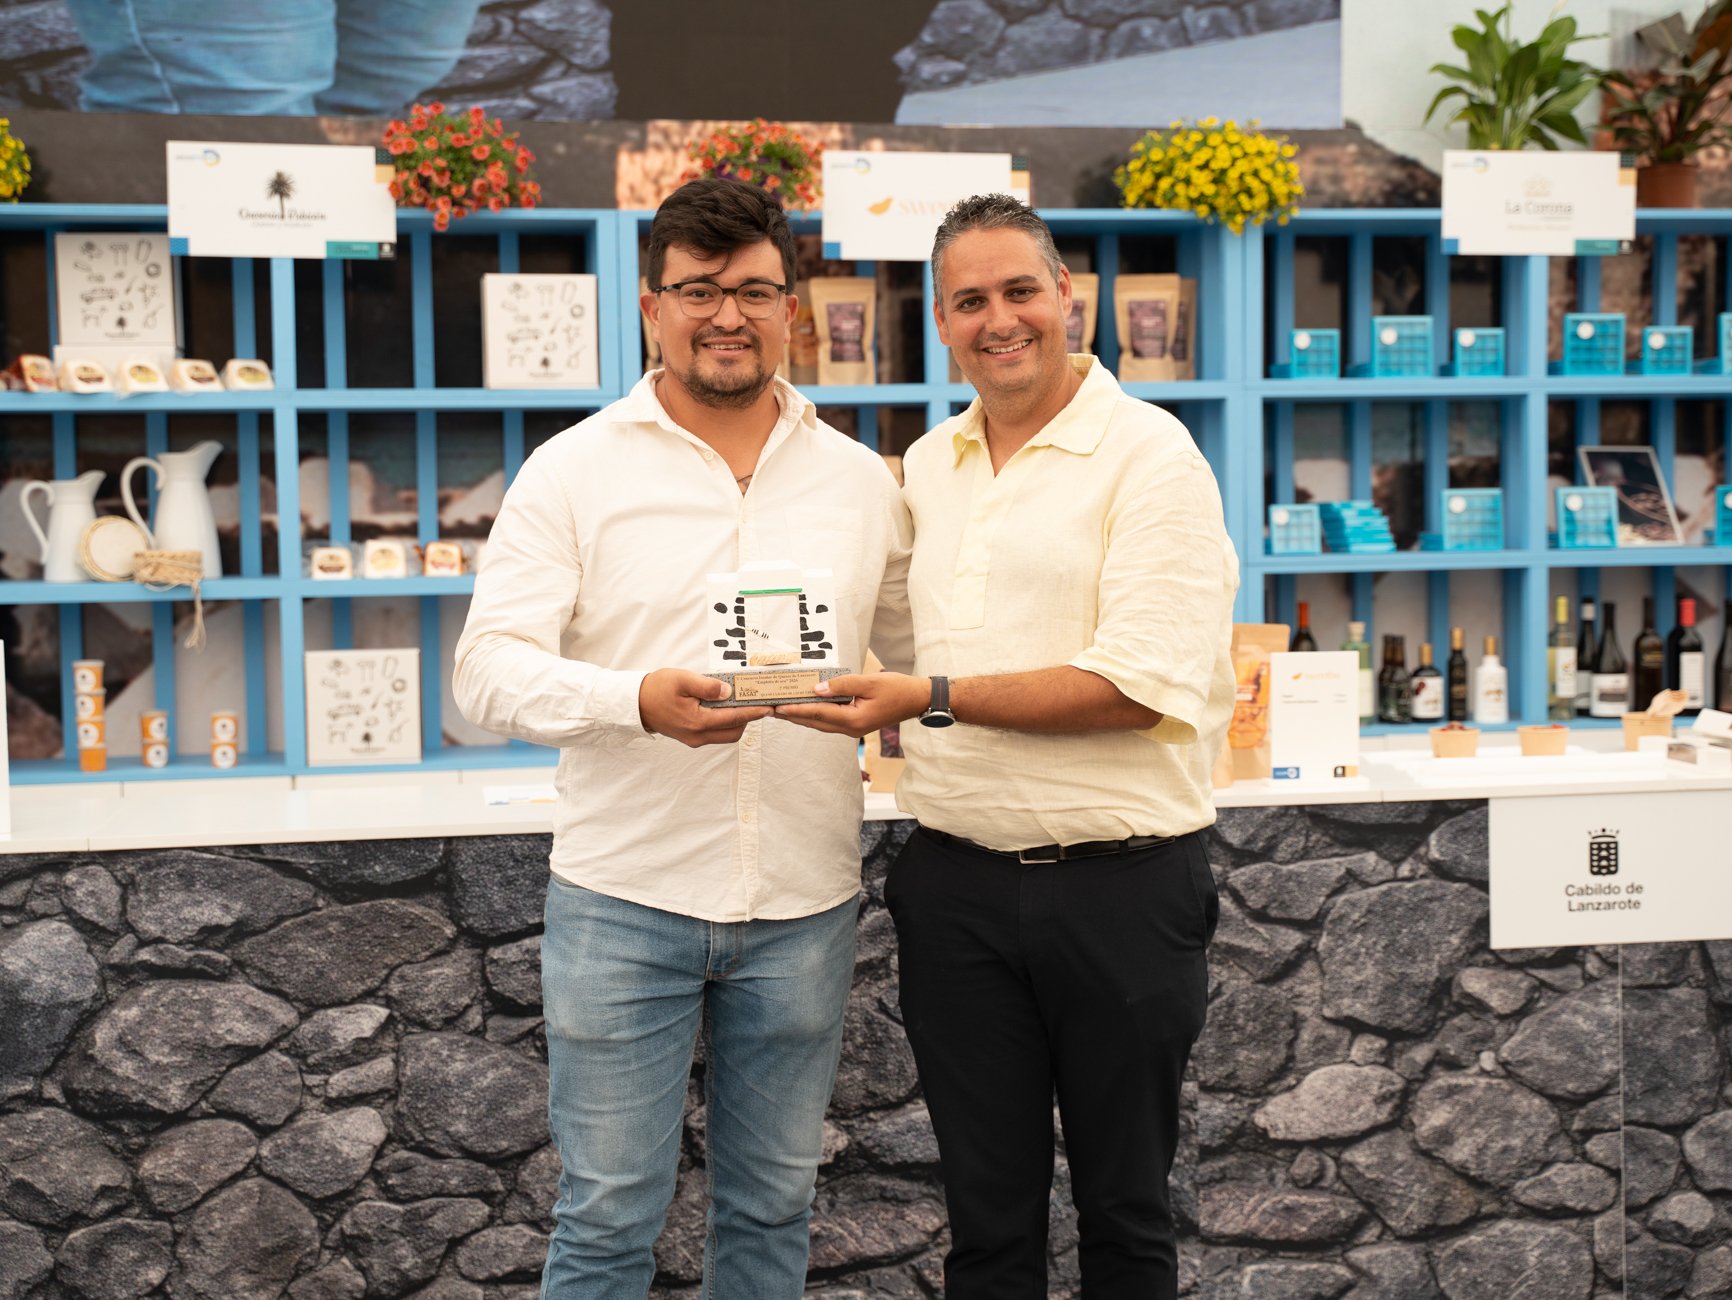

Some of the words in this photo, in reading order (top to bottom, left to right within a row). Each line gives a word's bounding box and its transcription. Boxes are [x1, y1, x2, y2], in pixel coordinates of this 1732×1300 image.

[1565, 883, 1621, 896] Cabildo
[1625, 882, 1644, 894] de
[1568, 899, 1642, 912] Lanzarote
